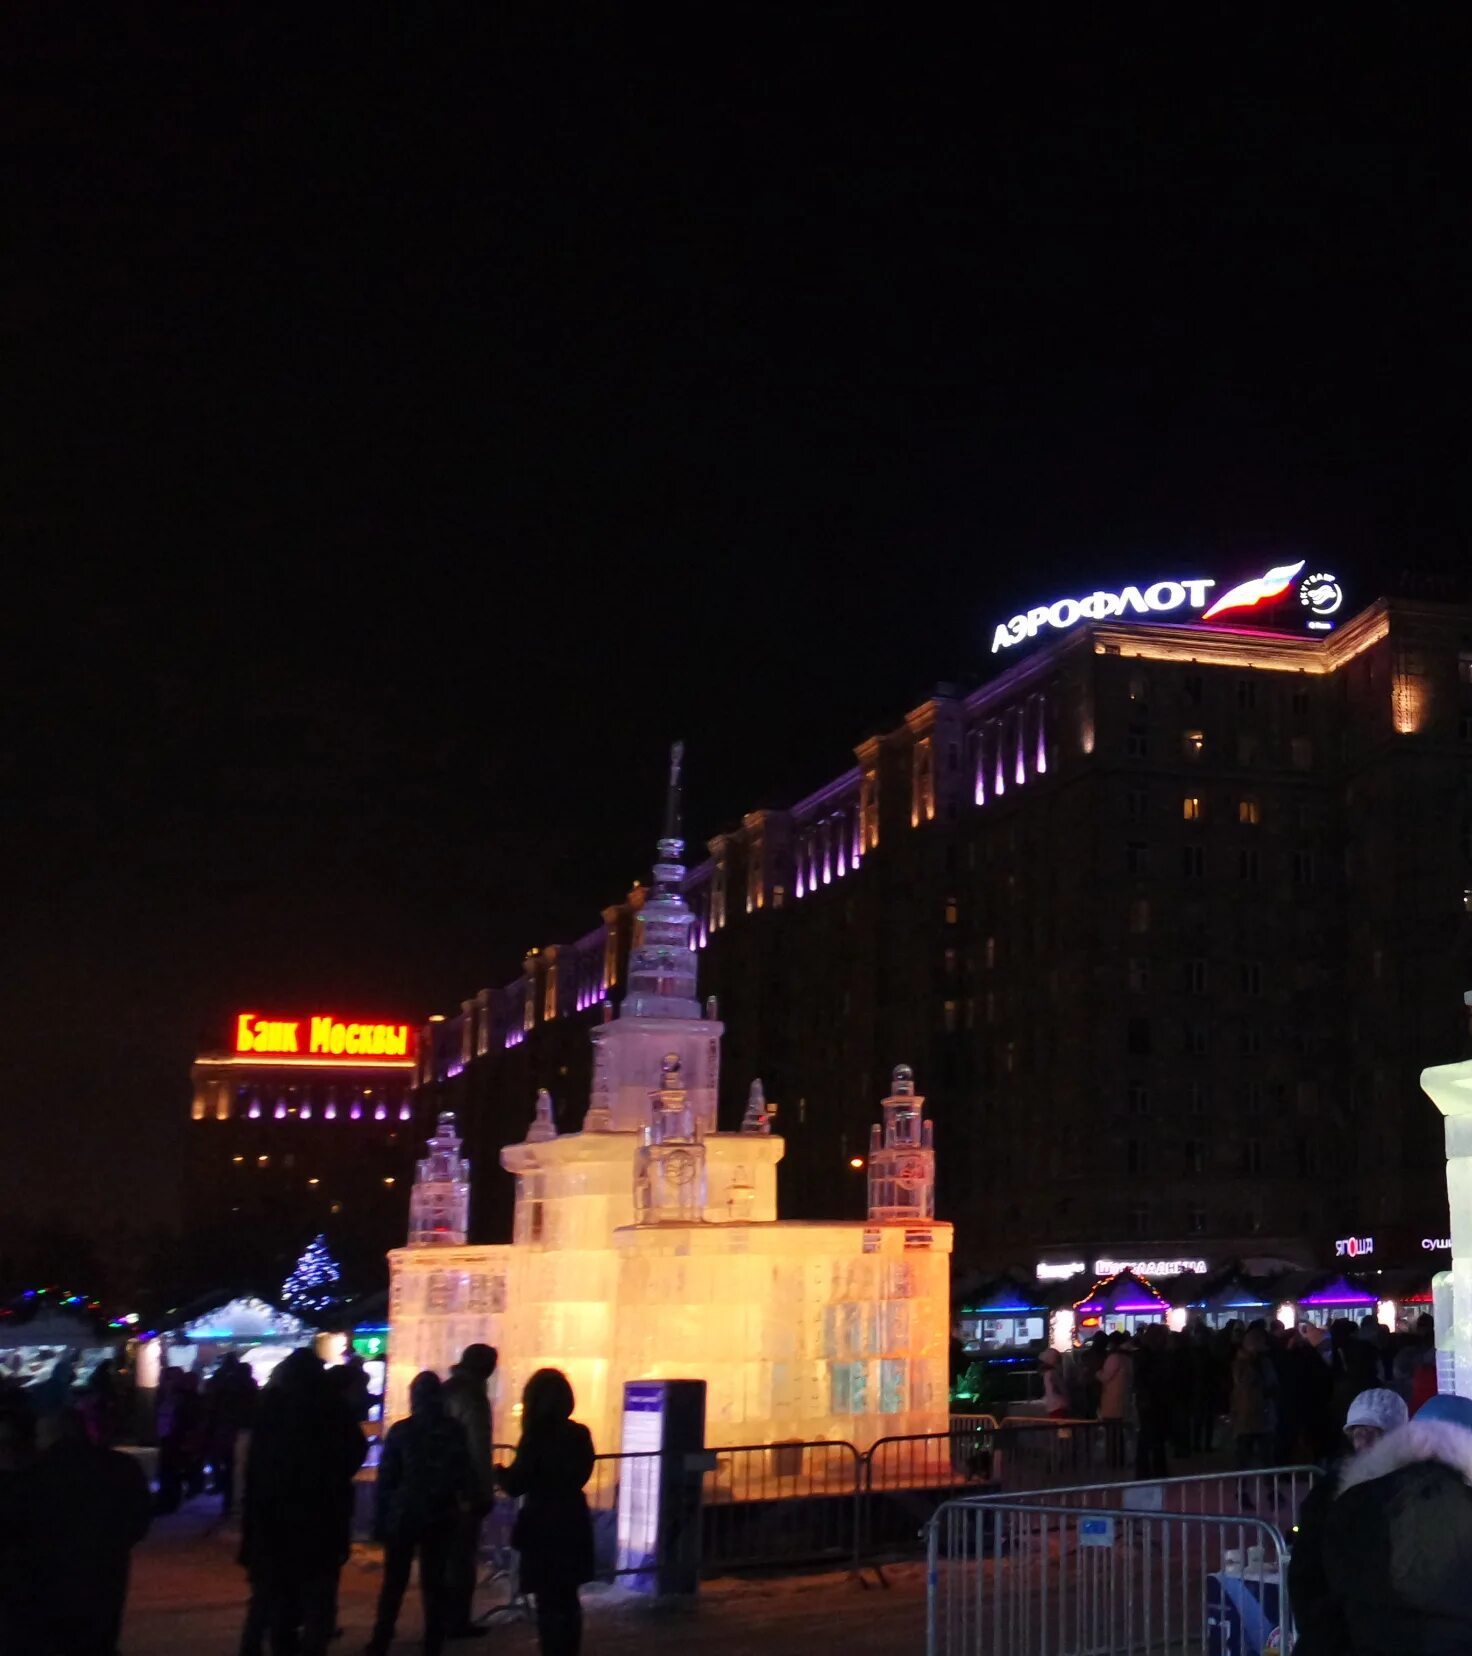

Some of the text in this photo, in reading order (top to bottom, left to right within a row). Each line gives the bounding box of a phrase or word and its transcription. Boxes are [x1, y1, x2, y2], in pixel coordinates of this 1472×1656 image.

[991, 579, 1215, 653] АЭРОФЛОТ
[236, 1013, 408, 1056] Банк Москвы
